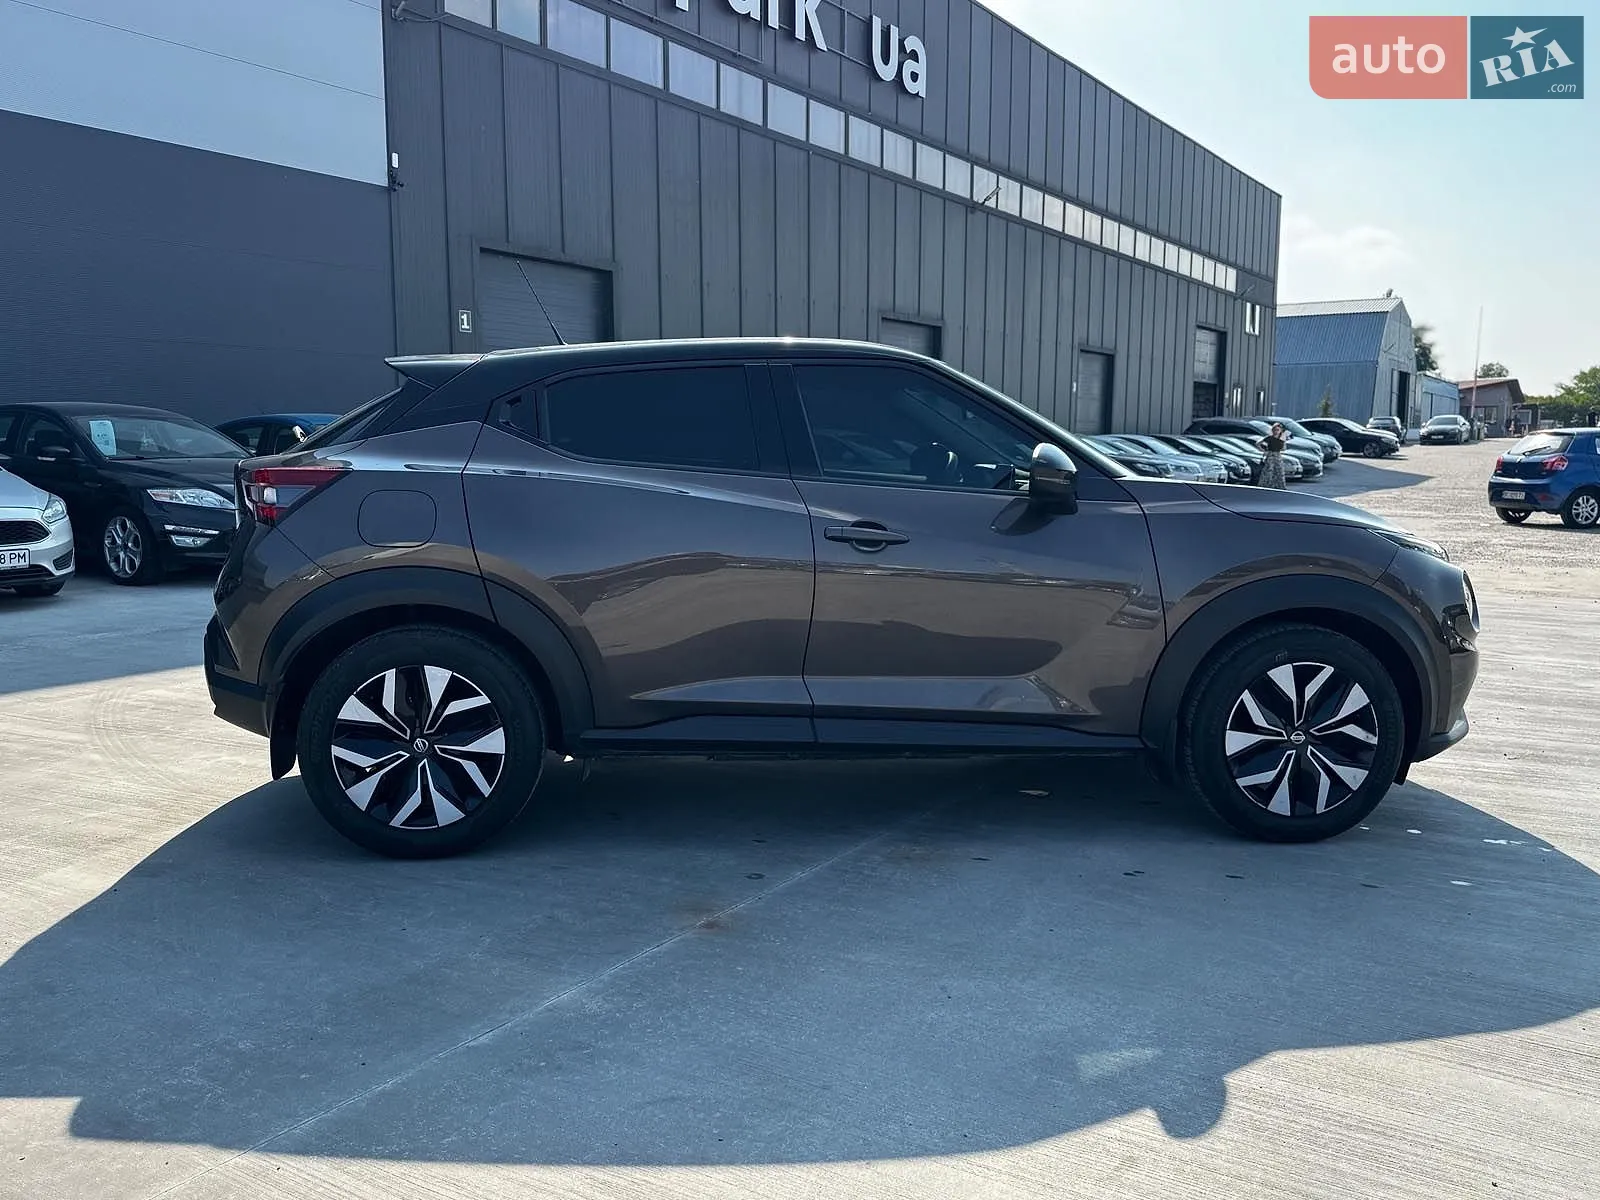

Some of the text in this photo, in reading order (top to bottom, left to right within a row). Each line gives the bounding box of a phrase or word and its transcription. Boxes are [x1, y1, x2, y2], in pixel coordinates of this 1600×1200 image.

[872, 14, 927, 98] ua
[461, 313, 470, 329] 1
[9, 551, 26, 564] PM
